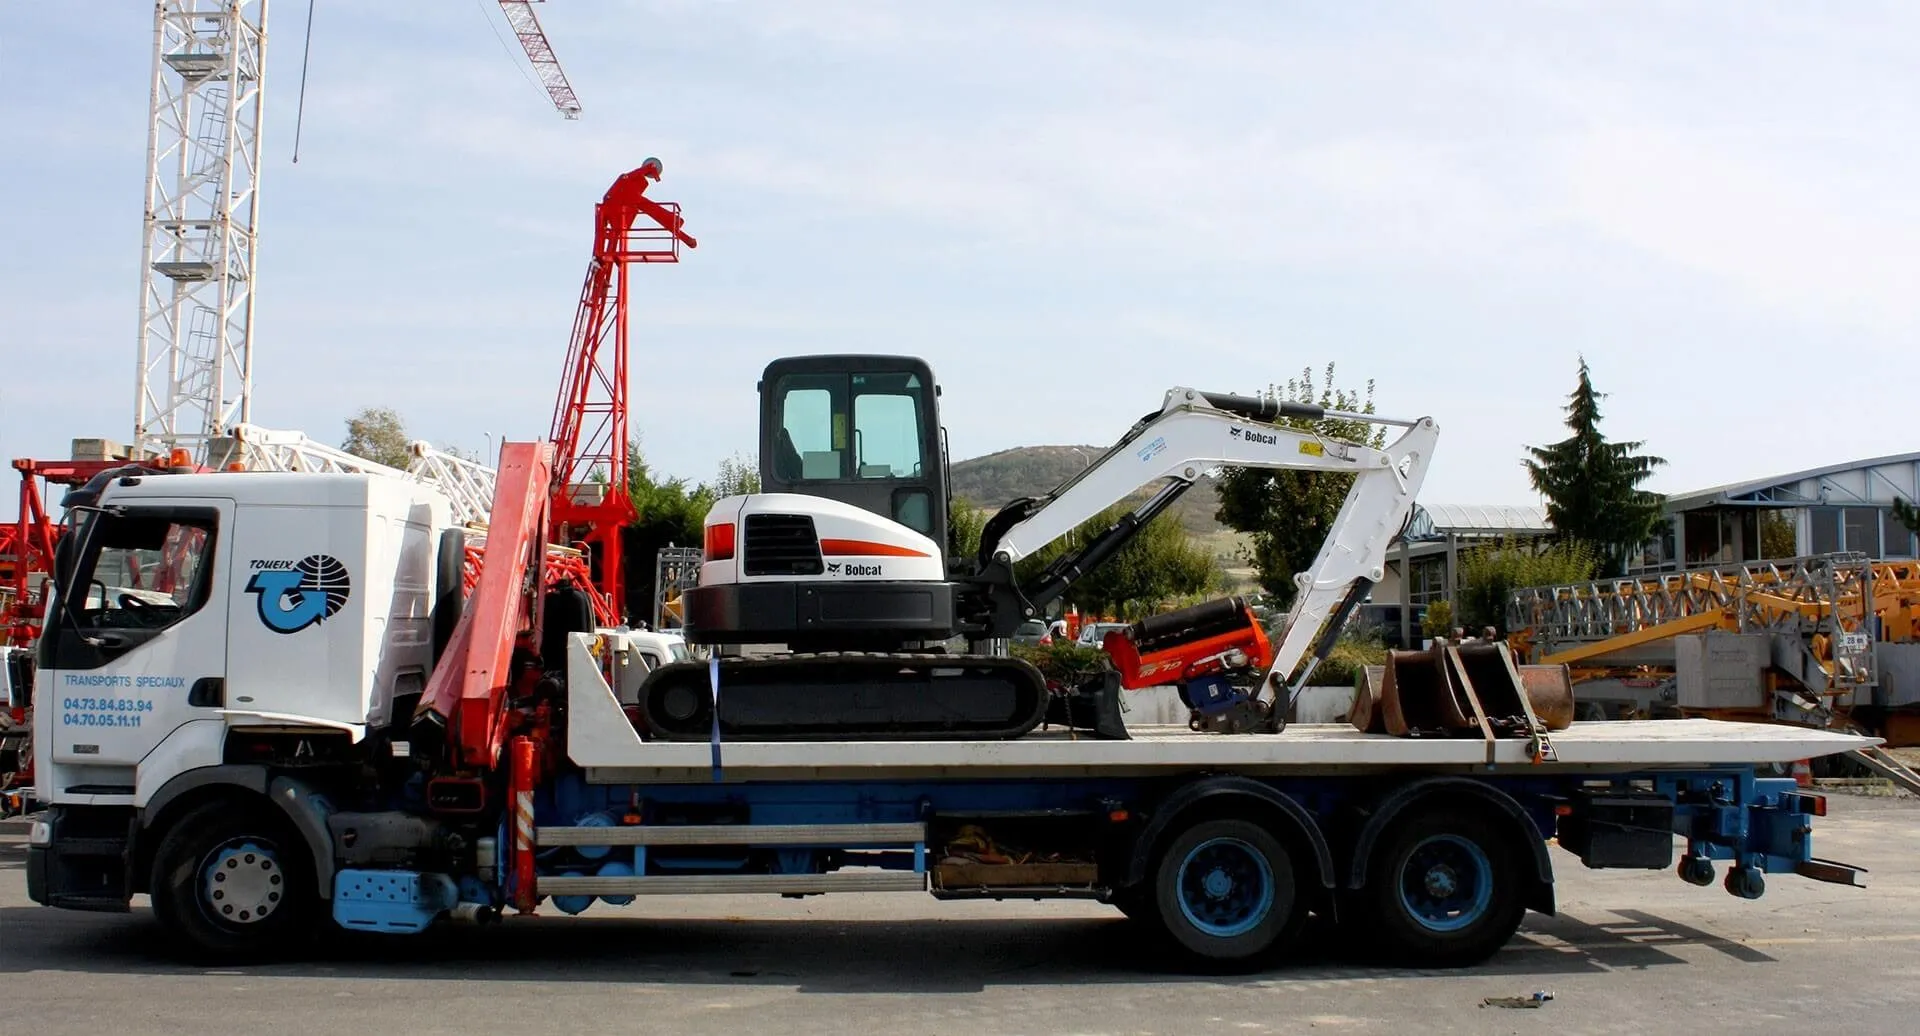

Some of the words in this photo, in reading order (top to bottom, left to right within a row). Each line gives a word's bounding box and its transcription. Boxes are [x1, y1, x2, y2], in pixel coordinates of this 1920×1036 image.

[1245, 430, 1277, 445] Bobcat
[250, 560, 293, 569] TOUEIX
[846, 564, 882, 576] Bobcat
[65, 675, 132, 687] TRANSPORTS
[136, 676, 185, 689] SPECIAUX
[64, 698, 153, 712] 04.73.84.83.94
[64, 714, 142, 727] 04.70.05.11.11
